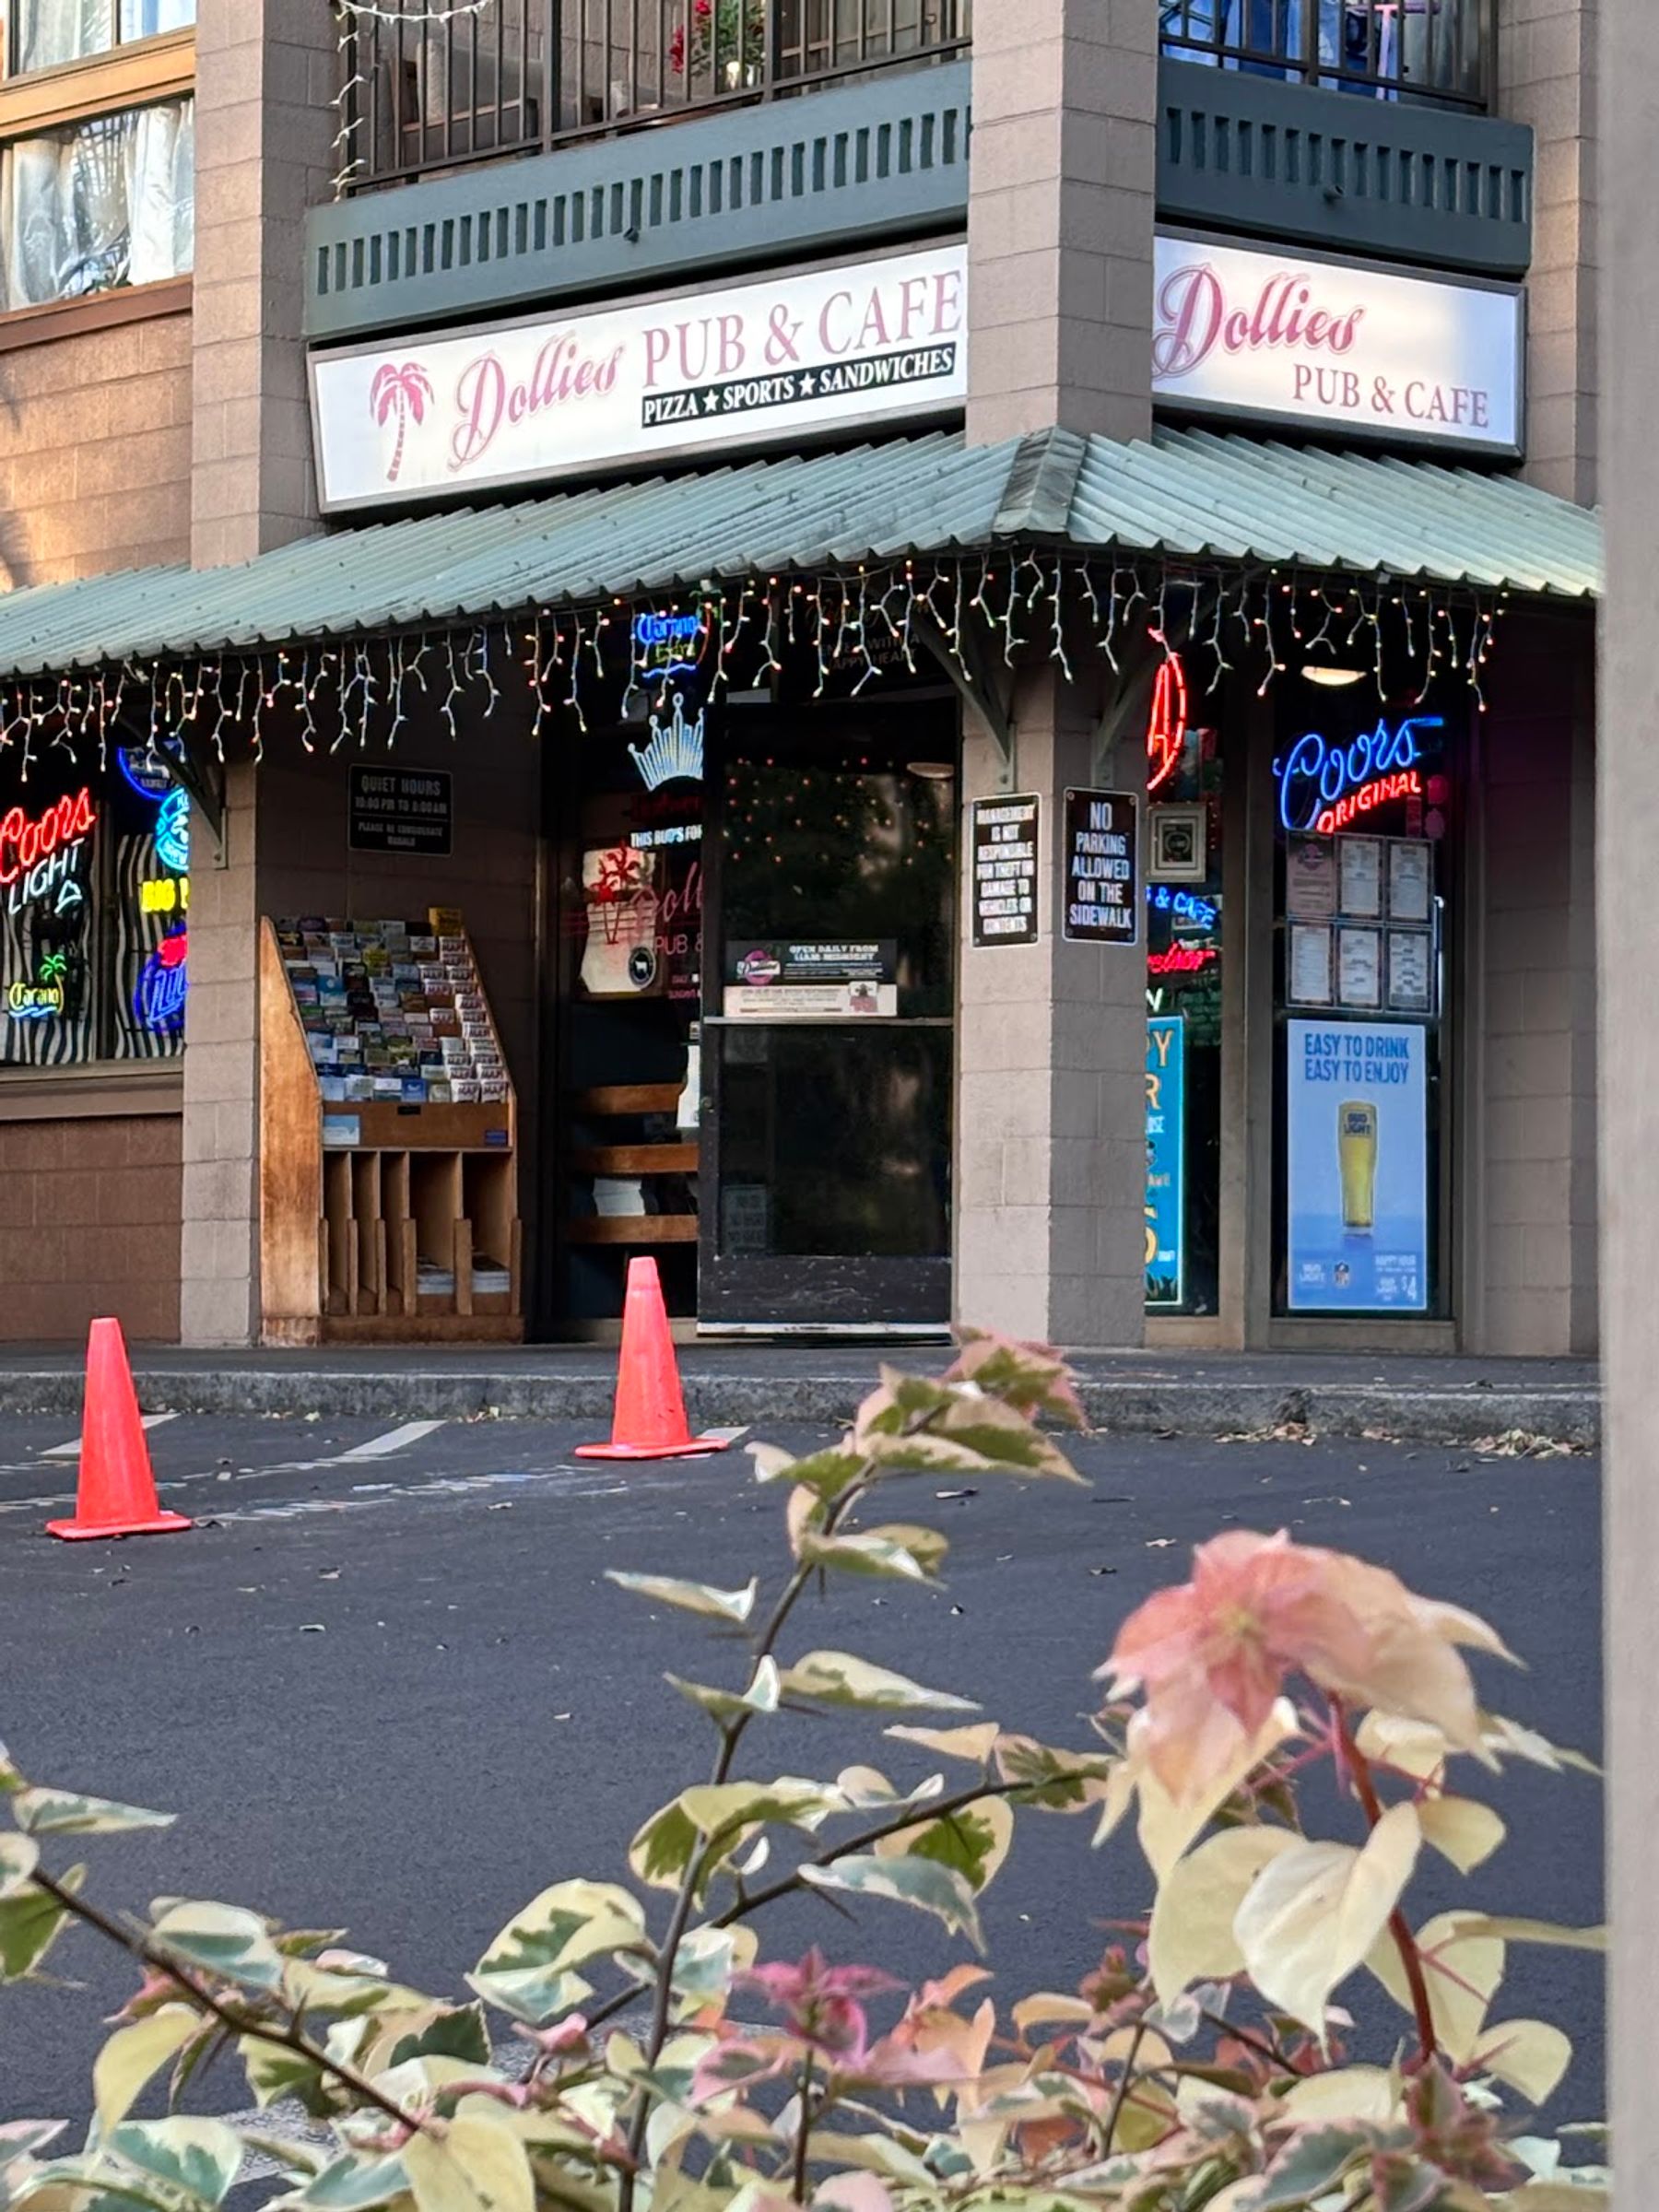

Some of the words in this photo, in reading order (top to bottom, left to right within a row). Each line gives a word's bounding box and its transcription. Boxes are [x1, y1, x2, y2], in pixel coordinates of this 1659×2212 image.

[642, 312, 745, 387] PUB
[763, 302, 804, 365] &
[818, 270, 962, 355] CAFE
[1152, 264, 1364, 381] Dollies
[644, 393, 698, 425] PIZZA
[724, 377, 794, 408] SPORTS
[818, 347, 955, 394] SANDWICHES
[1293, 364, 1360, 407] PUB
[1371, 376, 1396, 413] &
[1405, 381, 1489, 428] CAFE
[447, 330, 626, 473] Dollies
[361, 775, 395, 794] QUIET
[401, 778, 441, 795] HOURS
[1279, 717, 1442, 830] Coors
[1089, 802, 1113, 830] NO
[1316, 771, 1422, 833] ORIGINAL
[0, 787, 96, 884] Coors
[630, 831, 653, 848] THIS
[1076, 831, 1126, 855] PARKING
[8, 838, 85, 914] LIGHT
[1071, 855, 1131, 880] ALLOWED
[142, 879, 175, 912] BIG
[1077, 880, 1095, 901] ON
[1099, 882, 1124, 904] THE
[1069, 904, 1132, 929] SIDEWALK
[654, 934, 688, 956] PUB
[1304, 1033, 1340, 1056] EASY
[1345, 1035, 1362, 1057] TO
[1365, 1036, 1409, 1059] DRINK
[1305, 1059, 1340, 1081] EASY
[1346, 1060, 1362, 1082] TO
[1365, 1061, 1409, 1084] ENJOY
